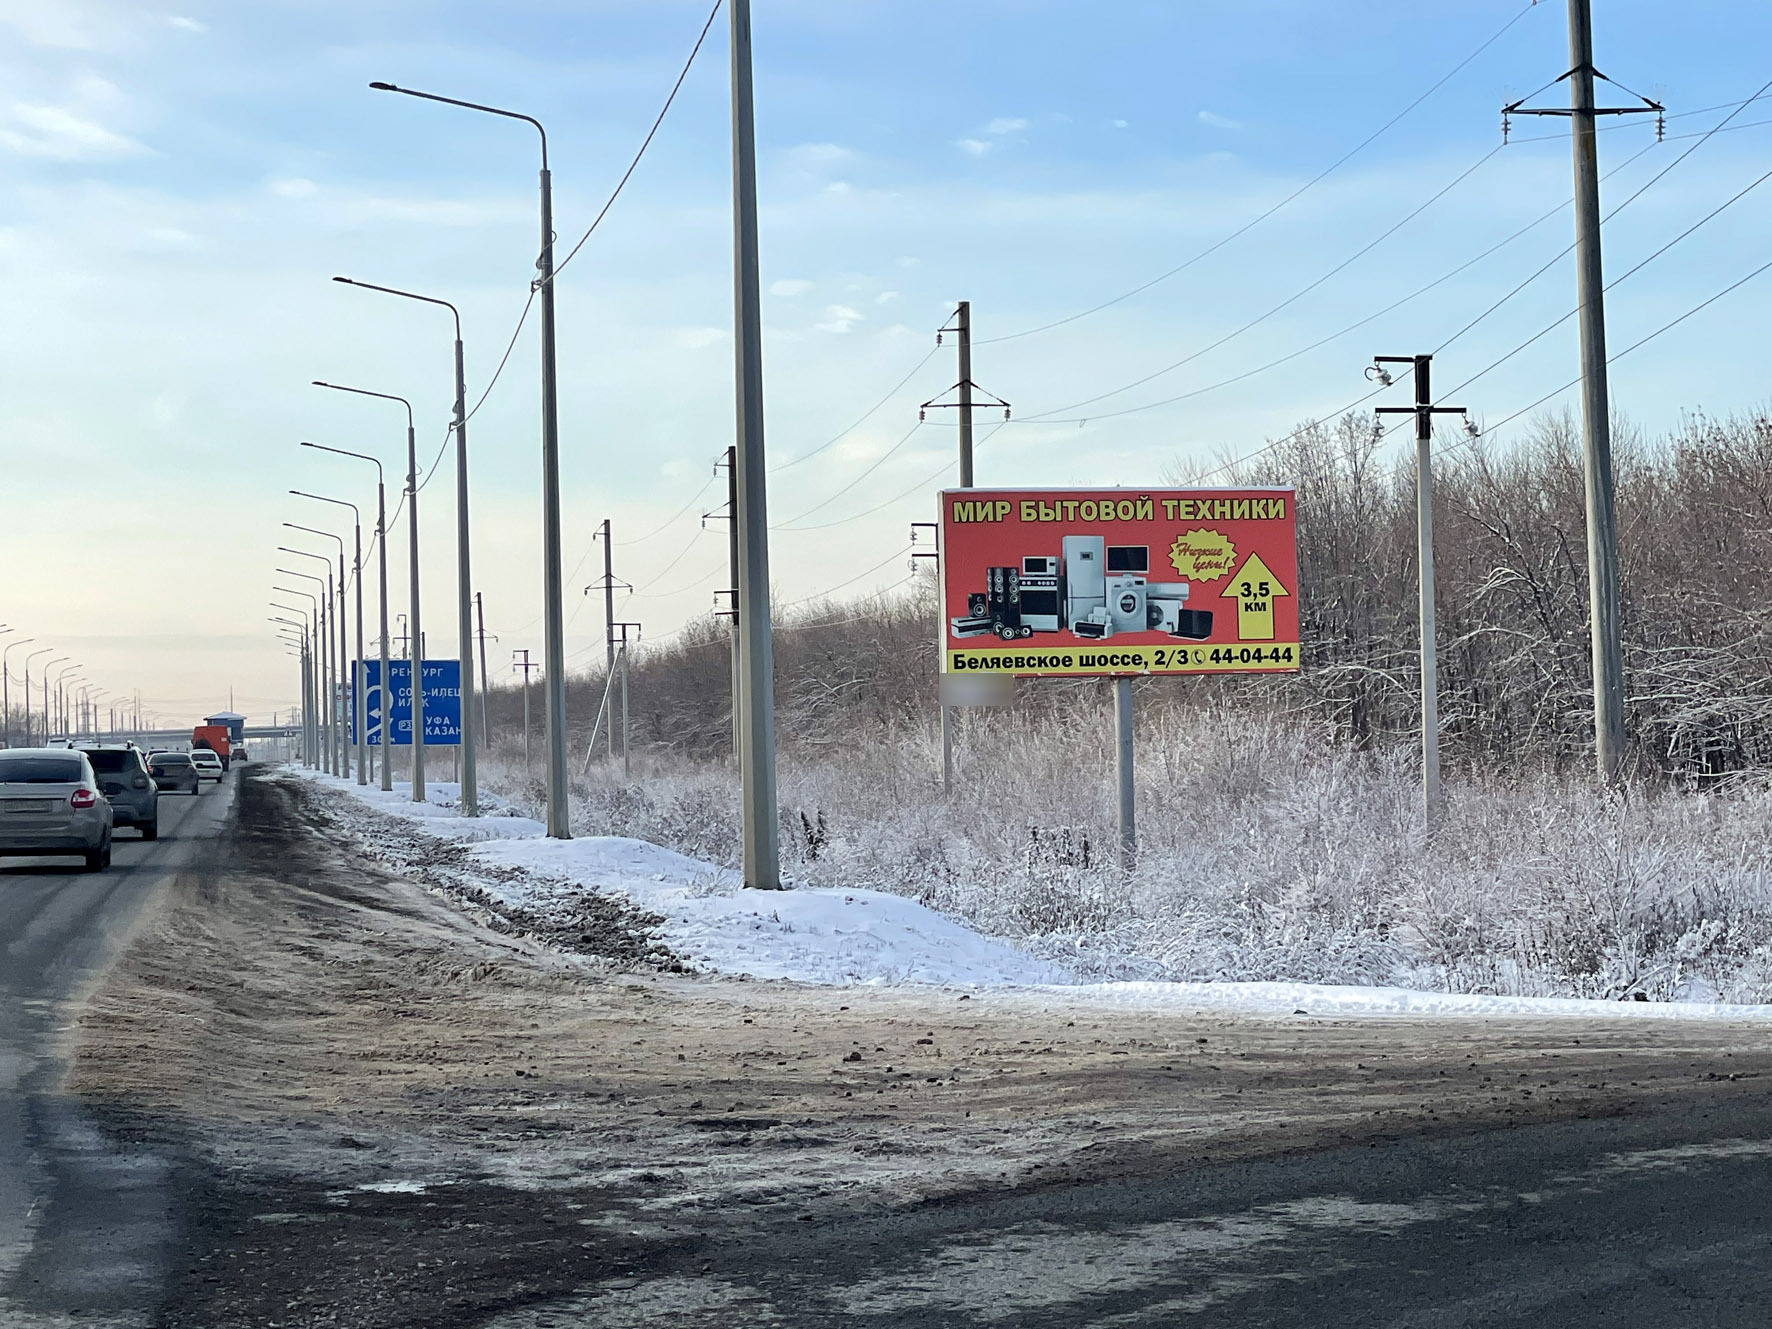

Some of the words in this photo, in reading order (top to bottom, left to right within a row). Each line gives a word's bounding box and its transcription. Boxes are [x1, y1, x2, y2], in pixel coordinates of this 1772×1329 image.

[953, 500, 1011, 523] МИР
[1020, 495, 1154, 522] БЫТОВОЙ
[1162, 498, 1286, 521] ТЕХНИКИ
[1176, 542, 1223, 561] Низкие
[1192, 556, 1230, 573] цены!
[1240, 581, 1270, 601] 3,5
[953, 653, 1073, 671] Беляевское
[1079, 651, 1149, 671] шоссе,
[1154, 649, 1189, 667] 2/3
[1210, 647, 1294, 665] 44-04-44
[388, 668, 444, 677] РЕНУРГ
[398, 687, 461, 697] СОЬ-ИЛЕЦ
[398, 697, 430, 707] ИЛК
[426, 716, 450, 725] УФА
[425, 726, 462, 736] КАЗАН
